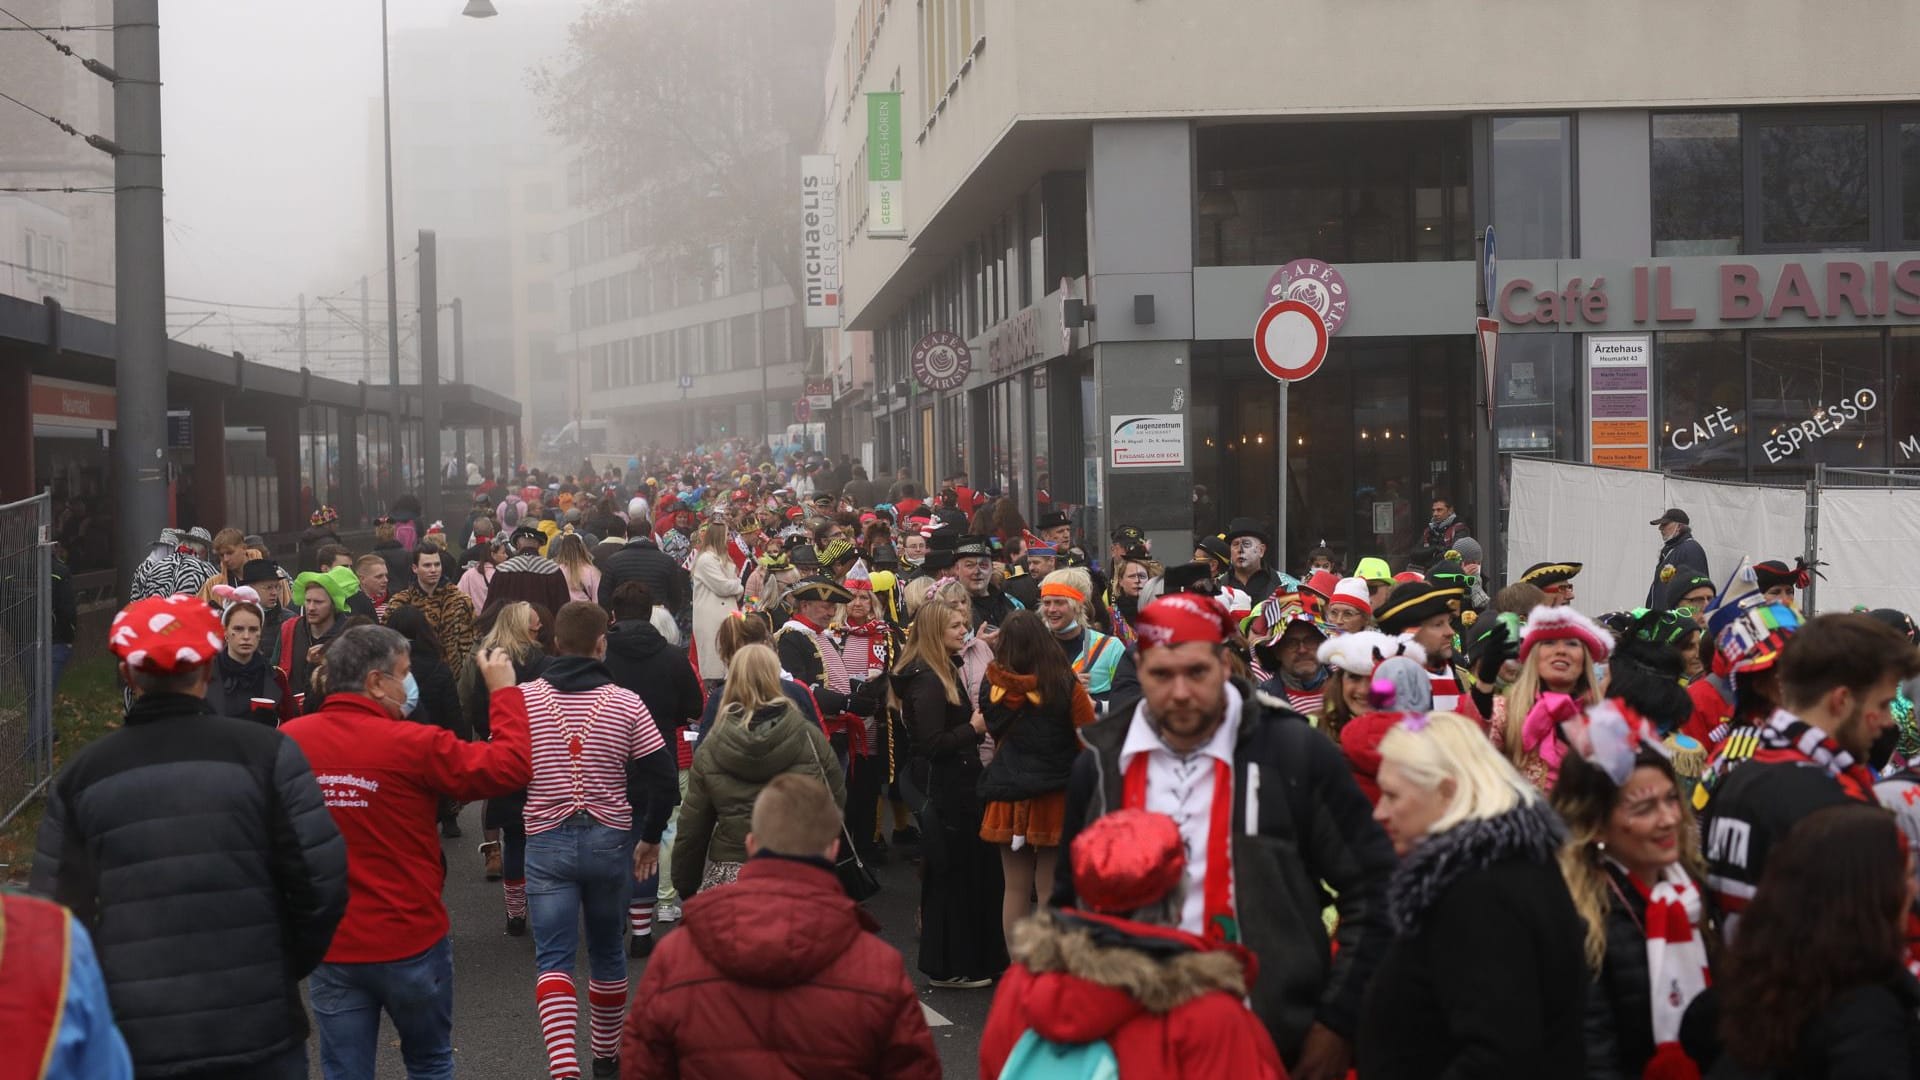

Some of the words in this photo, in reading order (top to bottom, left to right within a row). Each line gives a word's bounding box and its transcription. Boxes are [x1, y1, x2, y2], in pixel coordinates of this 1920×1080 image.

[878, 101, 889, 139] HÖREN
[880, 142, 891, 178] GUTES
[881, 191, 891, 224] GEERS
[1500, 275, 1610, 325] Café
[1632, 265, 1697, 323] IL
[922, 334, 960, 349] CAFÉ
[1594, 344, 1643, 354] Ärztehaus
[924, 360, 969, 389] BARISTA
[1671, 406, 1736, 451] CAFÈ
[1761, 388, 1887, 464] ESPRESSO
[338, 789, 360, 797] e.V.
